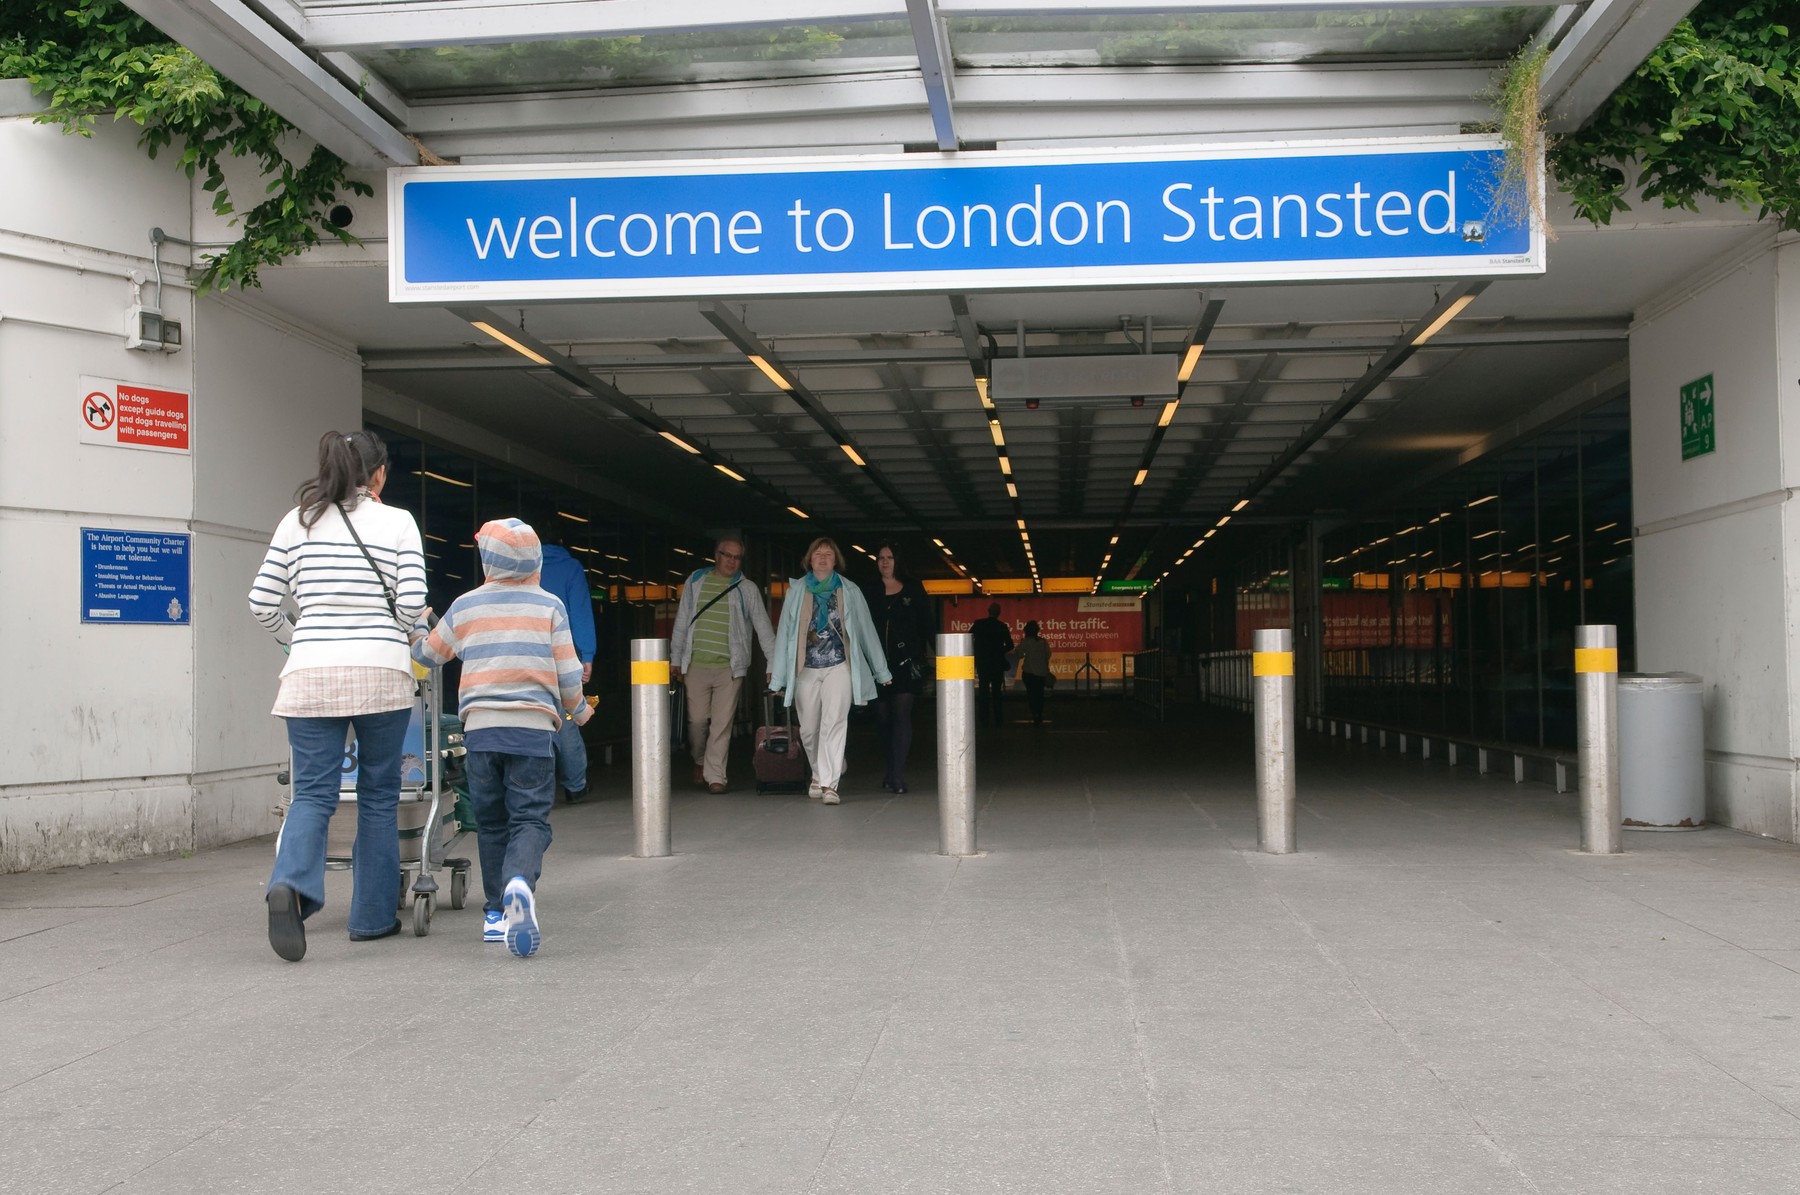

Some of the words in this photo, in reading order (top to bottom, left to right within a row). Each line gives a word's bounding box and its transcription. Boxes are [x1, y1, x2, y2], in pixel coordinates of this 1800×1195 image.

[466, 195, 762, 260] welcome
[787, 198, 855, 254] to
[883, 184, 1132, 251] London
[1161, 170, 1456, 244] Stansted
[119, 392, 130, 400] No
[131, 393, 150, 404] dogs
[120, 404, 144, 414] except
[146, 407, 165, 417] guide
[167, 409, 184, 420] dogs
[120, 416, 134, 424] and
[135, 417, 153, 428] dogs
[154, 418, 186, 432] travelling
[120, 426, 134, 434] with
[136, 428, 178, 440] passengers
[1704, 434, 1710, 450] 9
[86, 533, 100, 541] The
[101, 534, 124, 544] Airport
[126, 536, 161, 546] Community
[162, 537, 185, 546] Charter
[98, 543, 112, 551] here
[122, 544, 135, 554] help
[136, 546, 148, 554] you
[150, 546, 160, 554] but
[951, 620, 974, 631] Nex
[1016, 618, 1042, 630] bt
[1046, 619, 1066, 630] the
[1070, 618, 1110, 630] traffic.
[1086, 631, 1118, 639] between
[1050, 664, 1073, 673] AVEL
[1104, 664, 1118, 673] US
